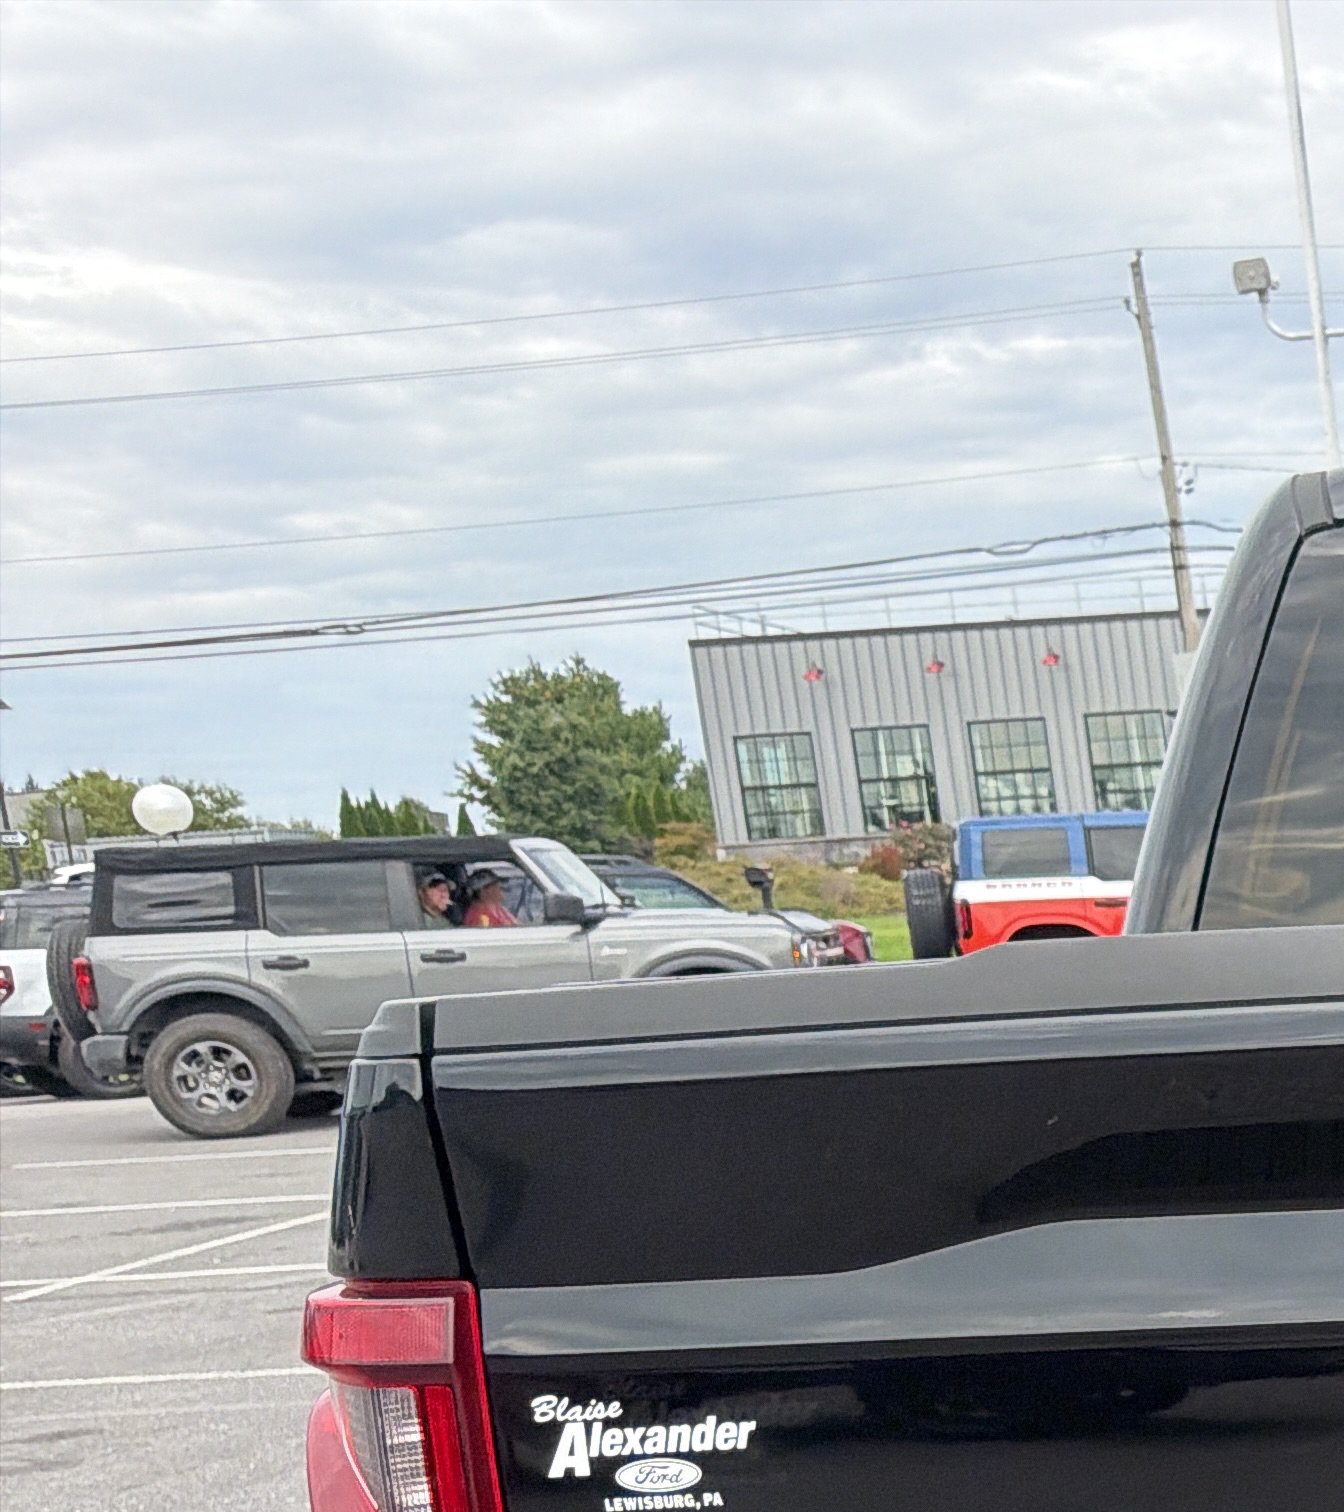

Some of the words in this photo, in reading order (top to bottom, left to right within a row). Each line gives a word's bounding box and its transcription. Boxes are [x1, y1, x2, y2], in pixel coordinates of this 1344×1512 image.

[530, 1394, 624, 1423] Blaise
[548, 1415, 757, 1479] Alexander
[634, 1464, 684, 1485] Ford
[603, 1493, 702, 1512] LEWISBURG,
[702, 1491, 725, 1507] PA
